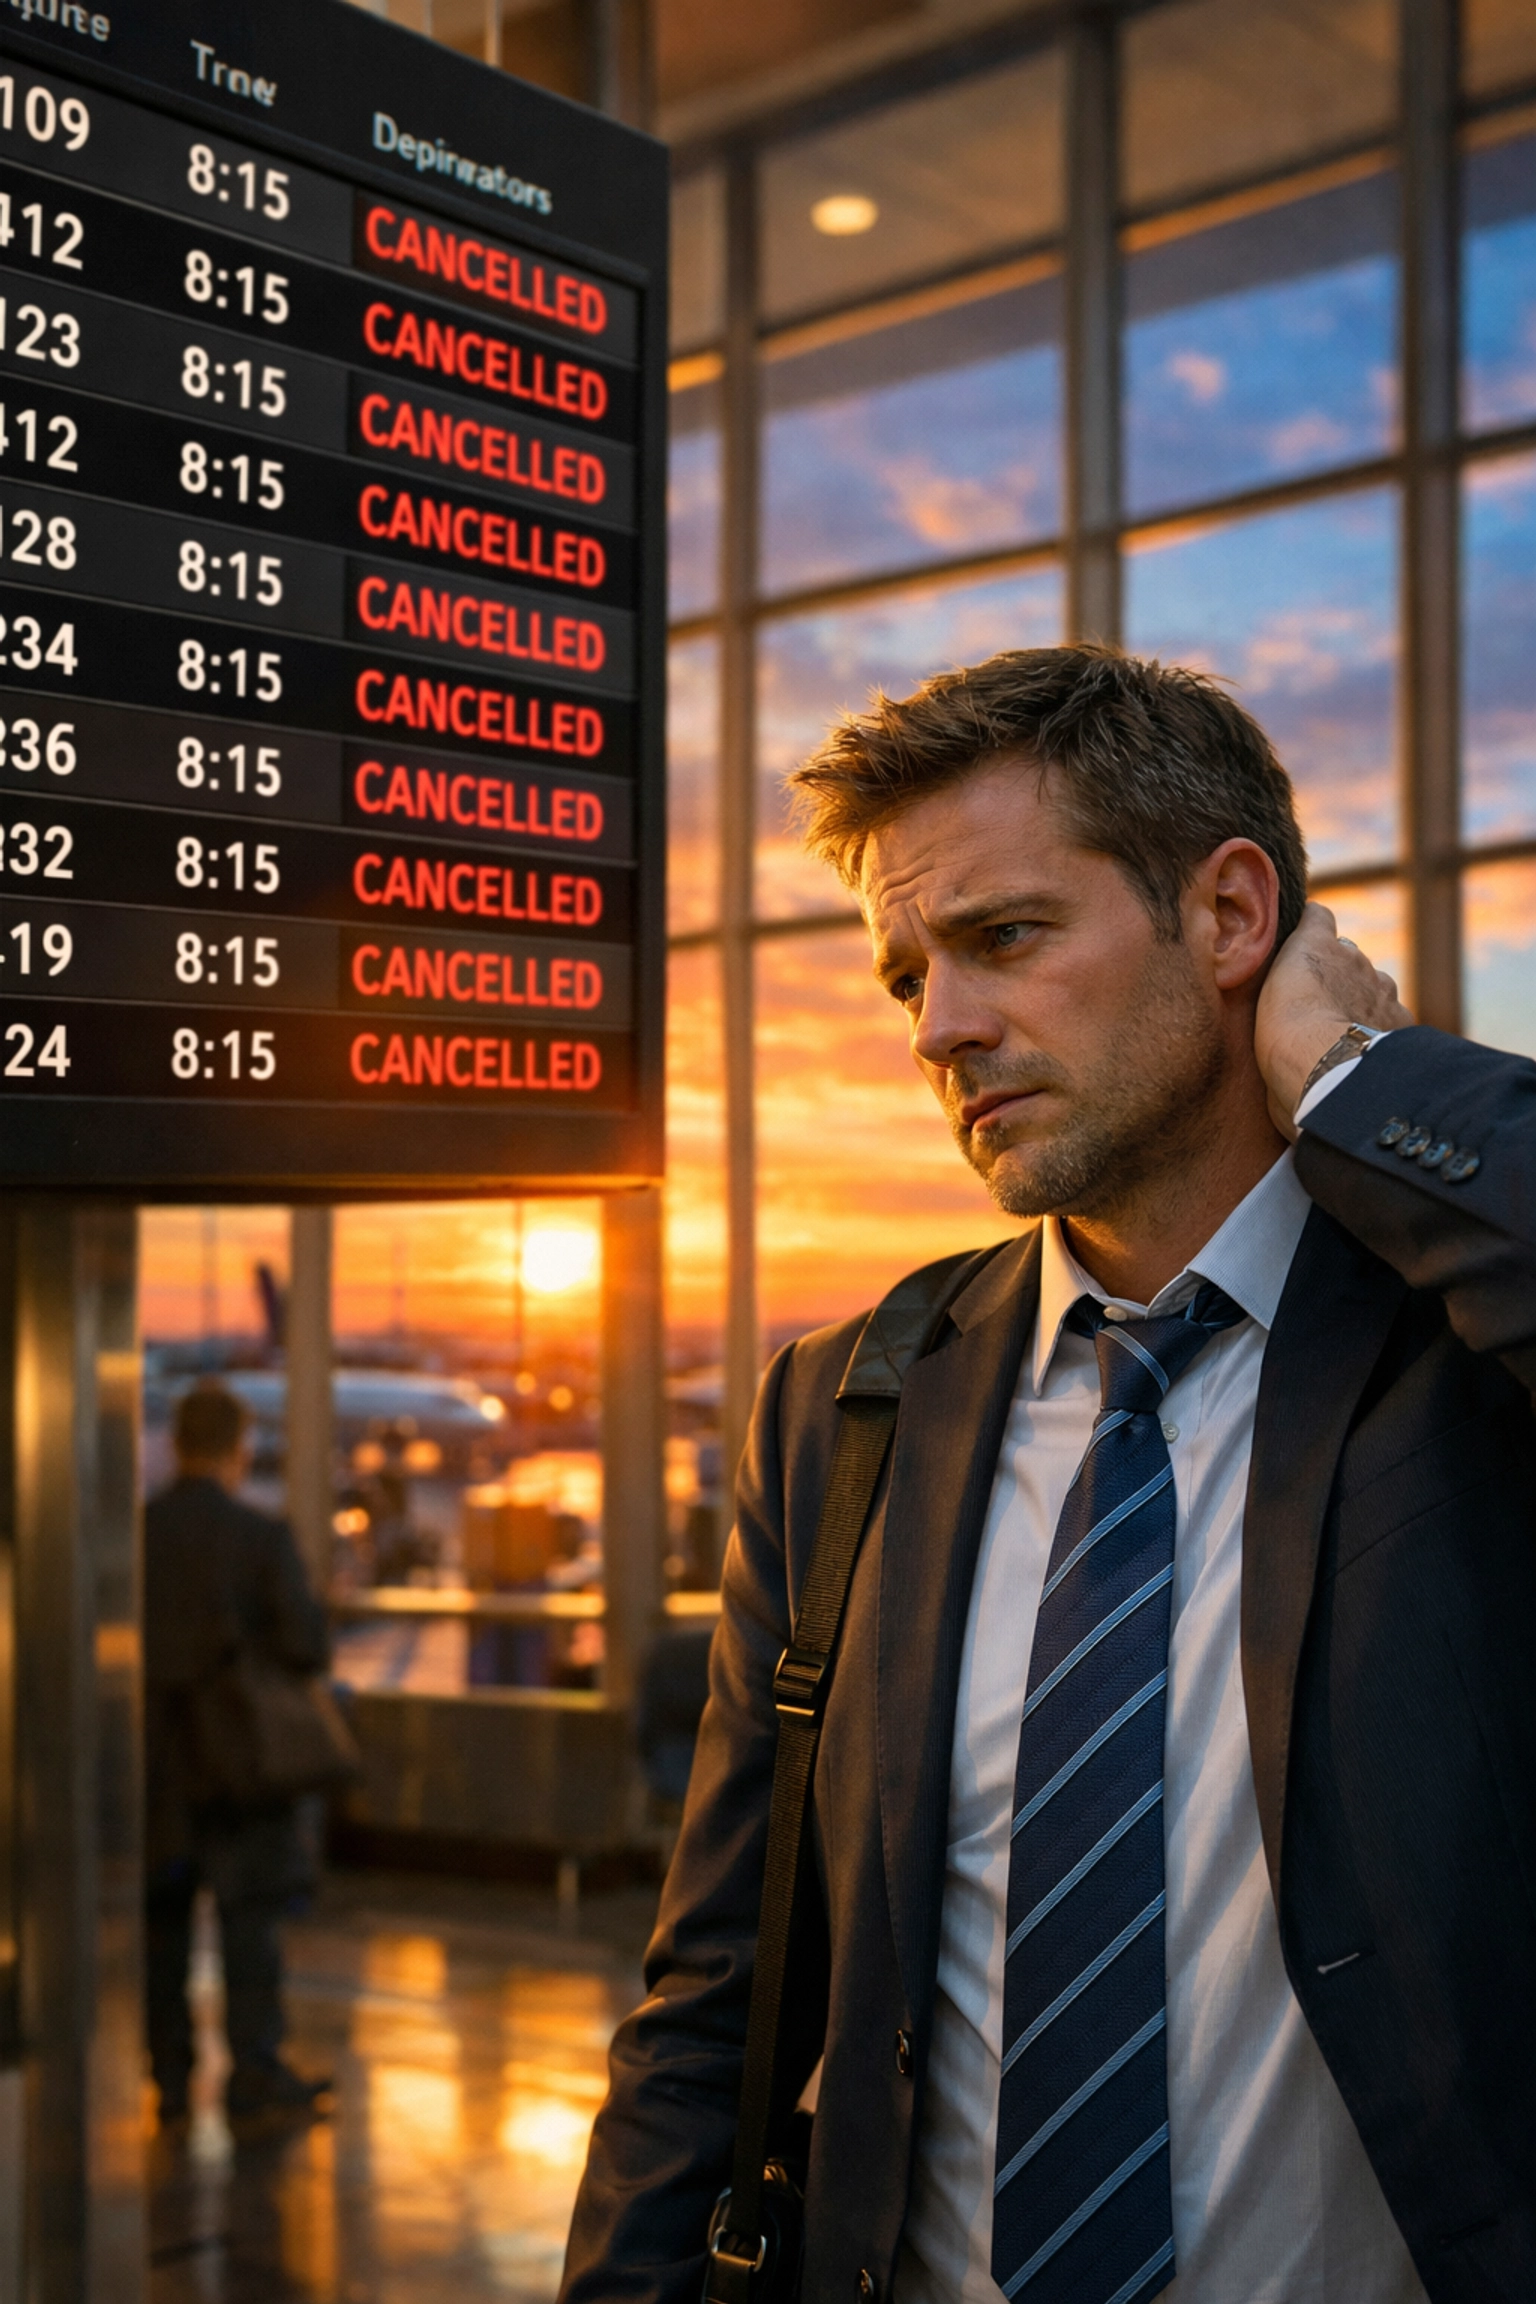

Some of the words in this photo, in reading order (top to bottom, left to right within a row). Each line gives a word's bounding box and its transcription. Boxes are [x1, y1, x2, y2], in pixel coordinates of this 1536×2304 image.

[0, 75, 90, 151] 109
[187, 144, 290, 220] 8:15
[365, 206, 607, 334] CANCELLED
[184, 250, 289, 324] 8:15
[364, 302, 607, 420] CANCELLED
[181, 345, 286, 417] 8:15
[360, 393, 606, 504] CANCELLED
[180, 441, 284, 510] 8:15
[359, 484, 606, 587] CANCELLED
[0, 505, 77, 570] 28
[178, 540, 283, 606] 8:15
[358, 576, 606, 672] CANCELLED
[0, 614, 78, 676] 34
[177, 639, 282, 702] 8:15
[356, 669, 604, 757] CANCELLED
[0, 718, 77, 776] 36
[176, 736, 281, 797] 8:15
[354, 761, 604, 842] CANCELLED
[0, 822, 74, 879] 32
[175, 836, 280, 894] 8:15
[353, 853, 603, 926] CANCELLED
[0, 922, 73, 977] 19
[175, 932, 280, 987] 8:15
[351, 943, 604, 1011] CANCELLED
[4, 1023, 71, 1077] 24
[171, 1027, 276, 1081] 8:15
[348, 1031, 603, 1093] CANCELLED
